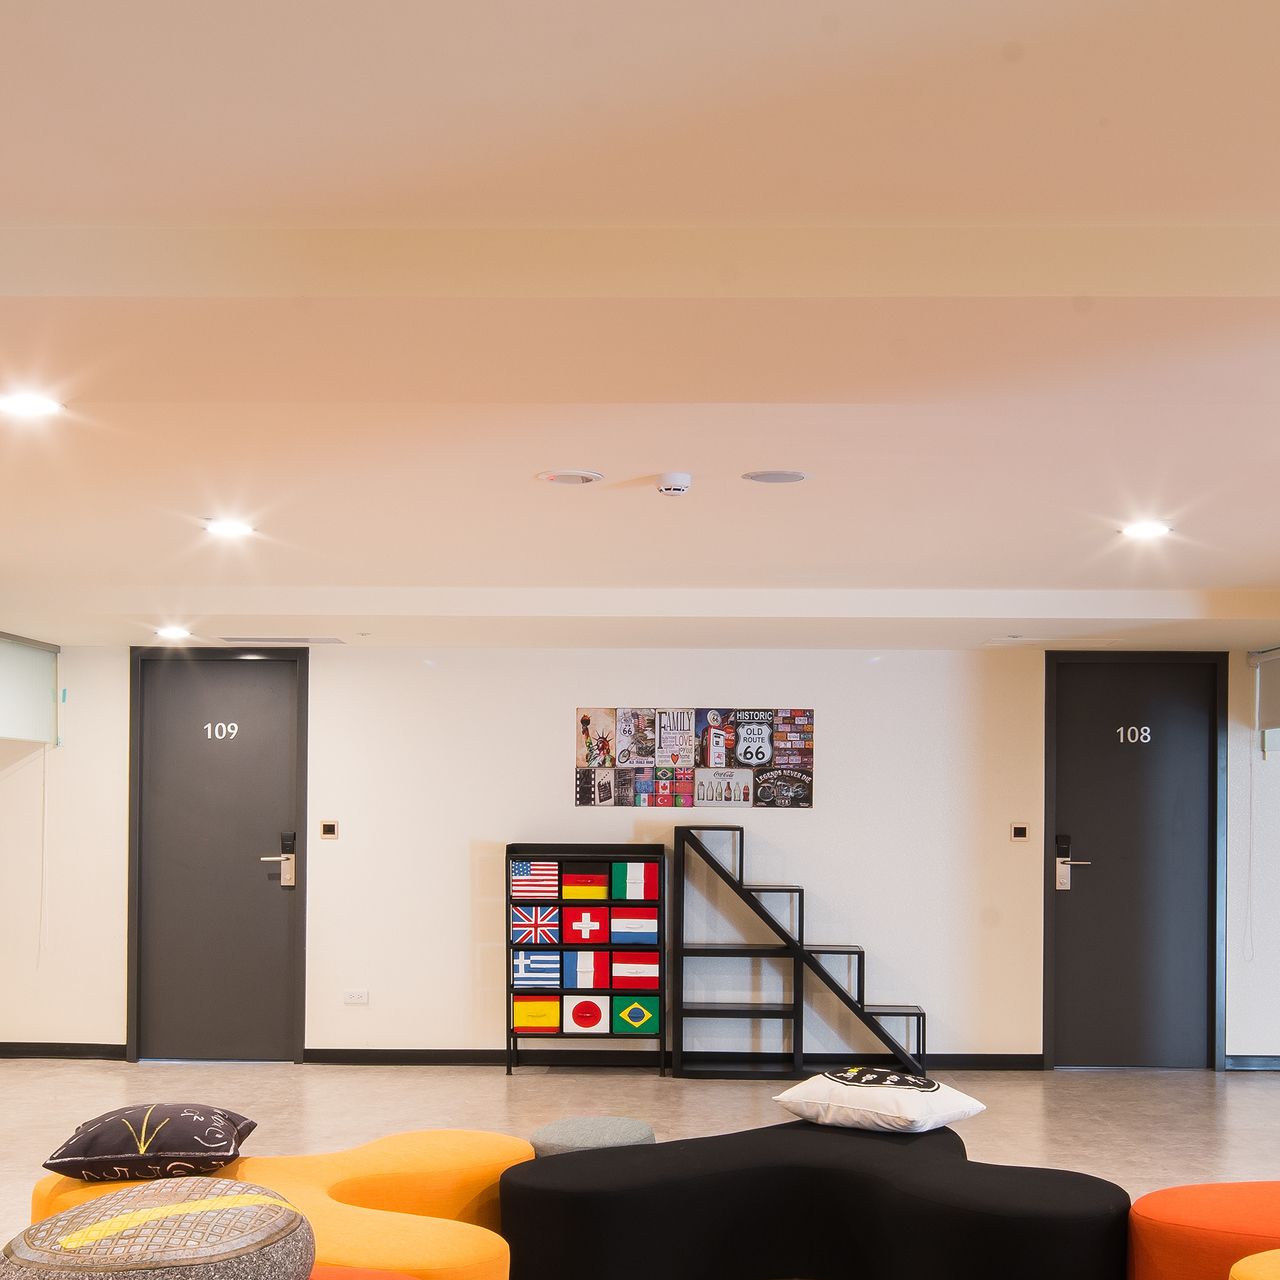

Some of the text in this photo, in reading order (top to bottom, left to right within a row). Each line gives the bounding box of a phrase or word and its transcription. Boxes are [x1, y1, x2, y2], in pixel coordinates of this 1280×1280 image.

[736, 711, 773, 720] HISTORIC
[203, 723, 239, 740] 109
[622, 727, 632, 735] 66
[746, 728, 763, 736] OLD
[1116, 726, 1151, 743] 108
[674, 735, 692, 746] LOVE
[743, 745, 765, 760] 66
[755, 769, 813, 784] LEGENDS NEVER DIE
